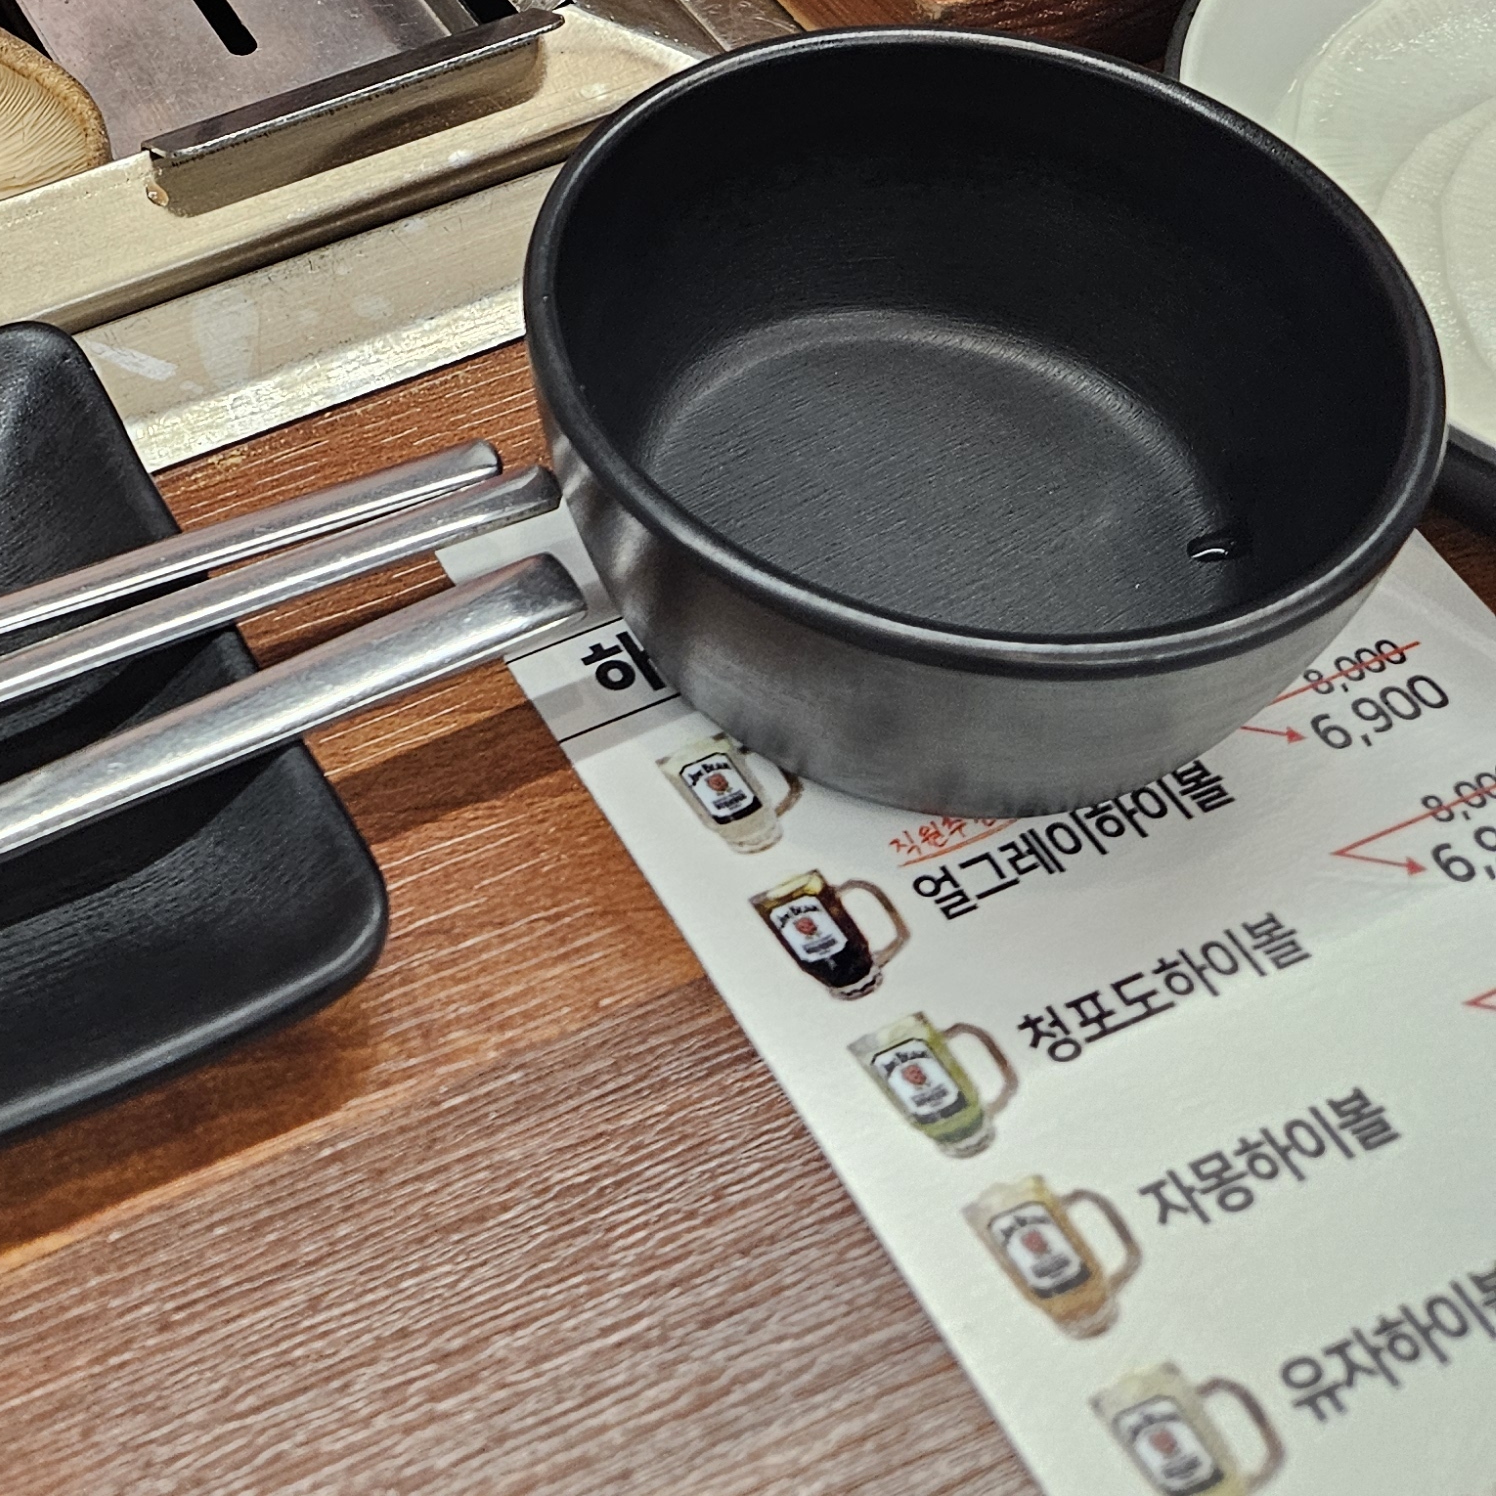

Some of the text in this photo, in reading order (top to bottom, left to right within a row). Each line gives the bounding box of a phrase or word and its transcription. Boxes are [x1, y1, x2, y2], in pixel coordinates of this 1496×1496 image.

[1303, 639, 1407, 695] 8,000
[1310, 675, 1450, 750] 6,900
[912, 759, 1236, 921] 얼그레이하이볼
[1421, 765, 1496, 822] 8,00
[1017, 911, 1312, 1063] 청포도하이볼
[1139, 1087, 1403, 1226] 자몽하이볼
